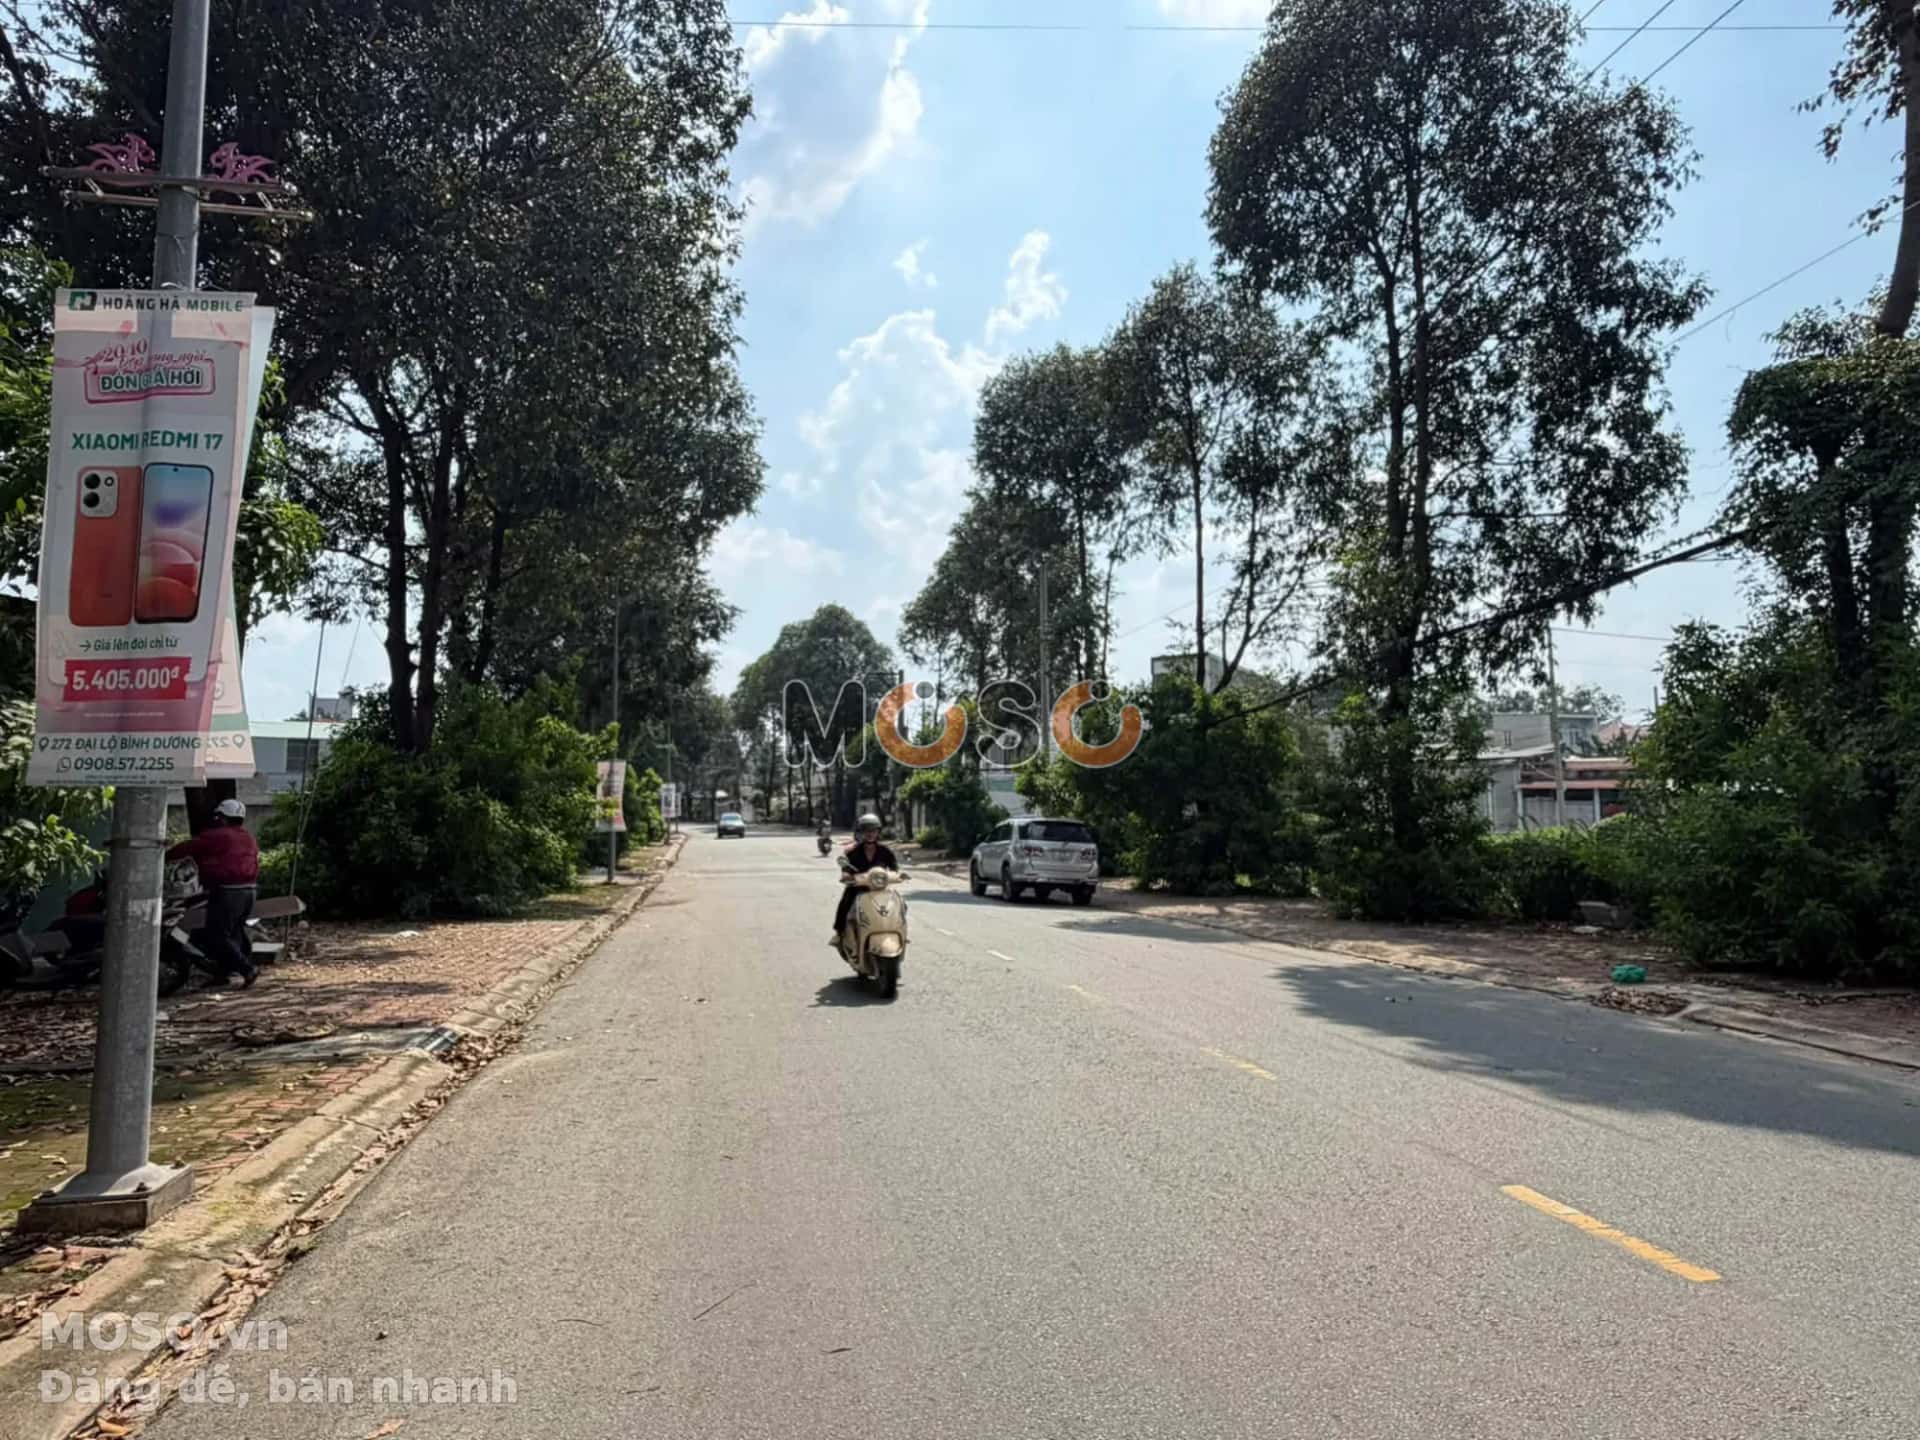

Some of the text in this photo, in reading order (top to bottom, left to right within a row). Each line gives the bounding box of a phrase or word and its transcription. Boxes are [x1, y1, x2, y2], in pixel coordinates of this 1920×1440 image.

[103, 295, 243, 312] HOÀNG HÀ MOBILE
[101, 371, 138, 391] ĐÓN
[170, 366, 201, 385] HỜI
[71, 430, 224, 450] XIAOMI REDMI 17
[51, 733, 200, 752] 272 ĐẠI LỘ BÌNH DƯƠNG
[73, 757, 174, 770] 0908.57.2255
